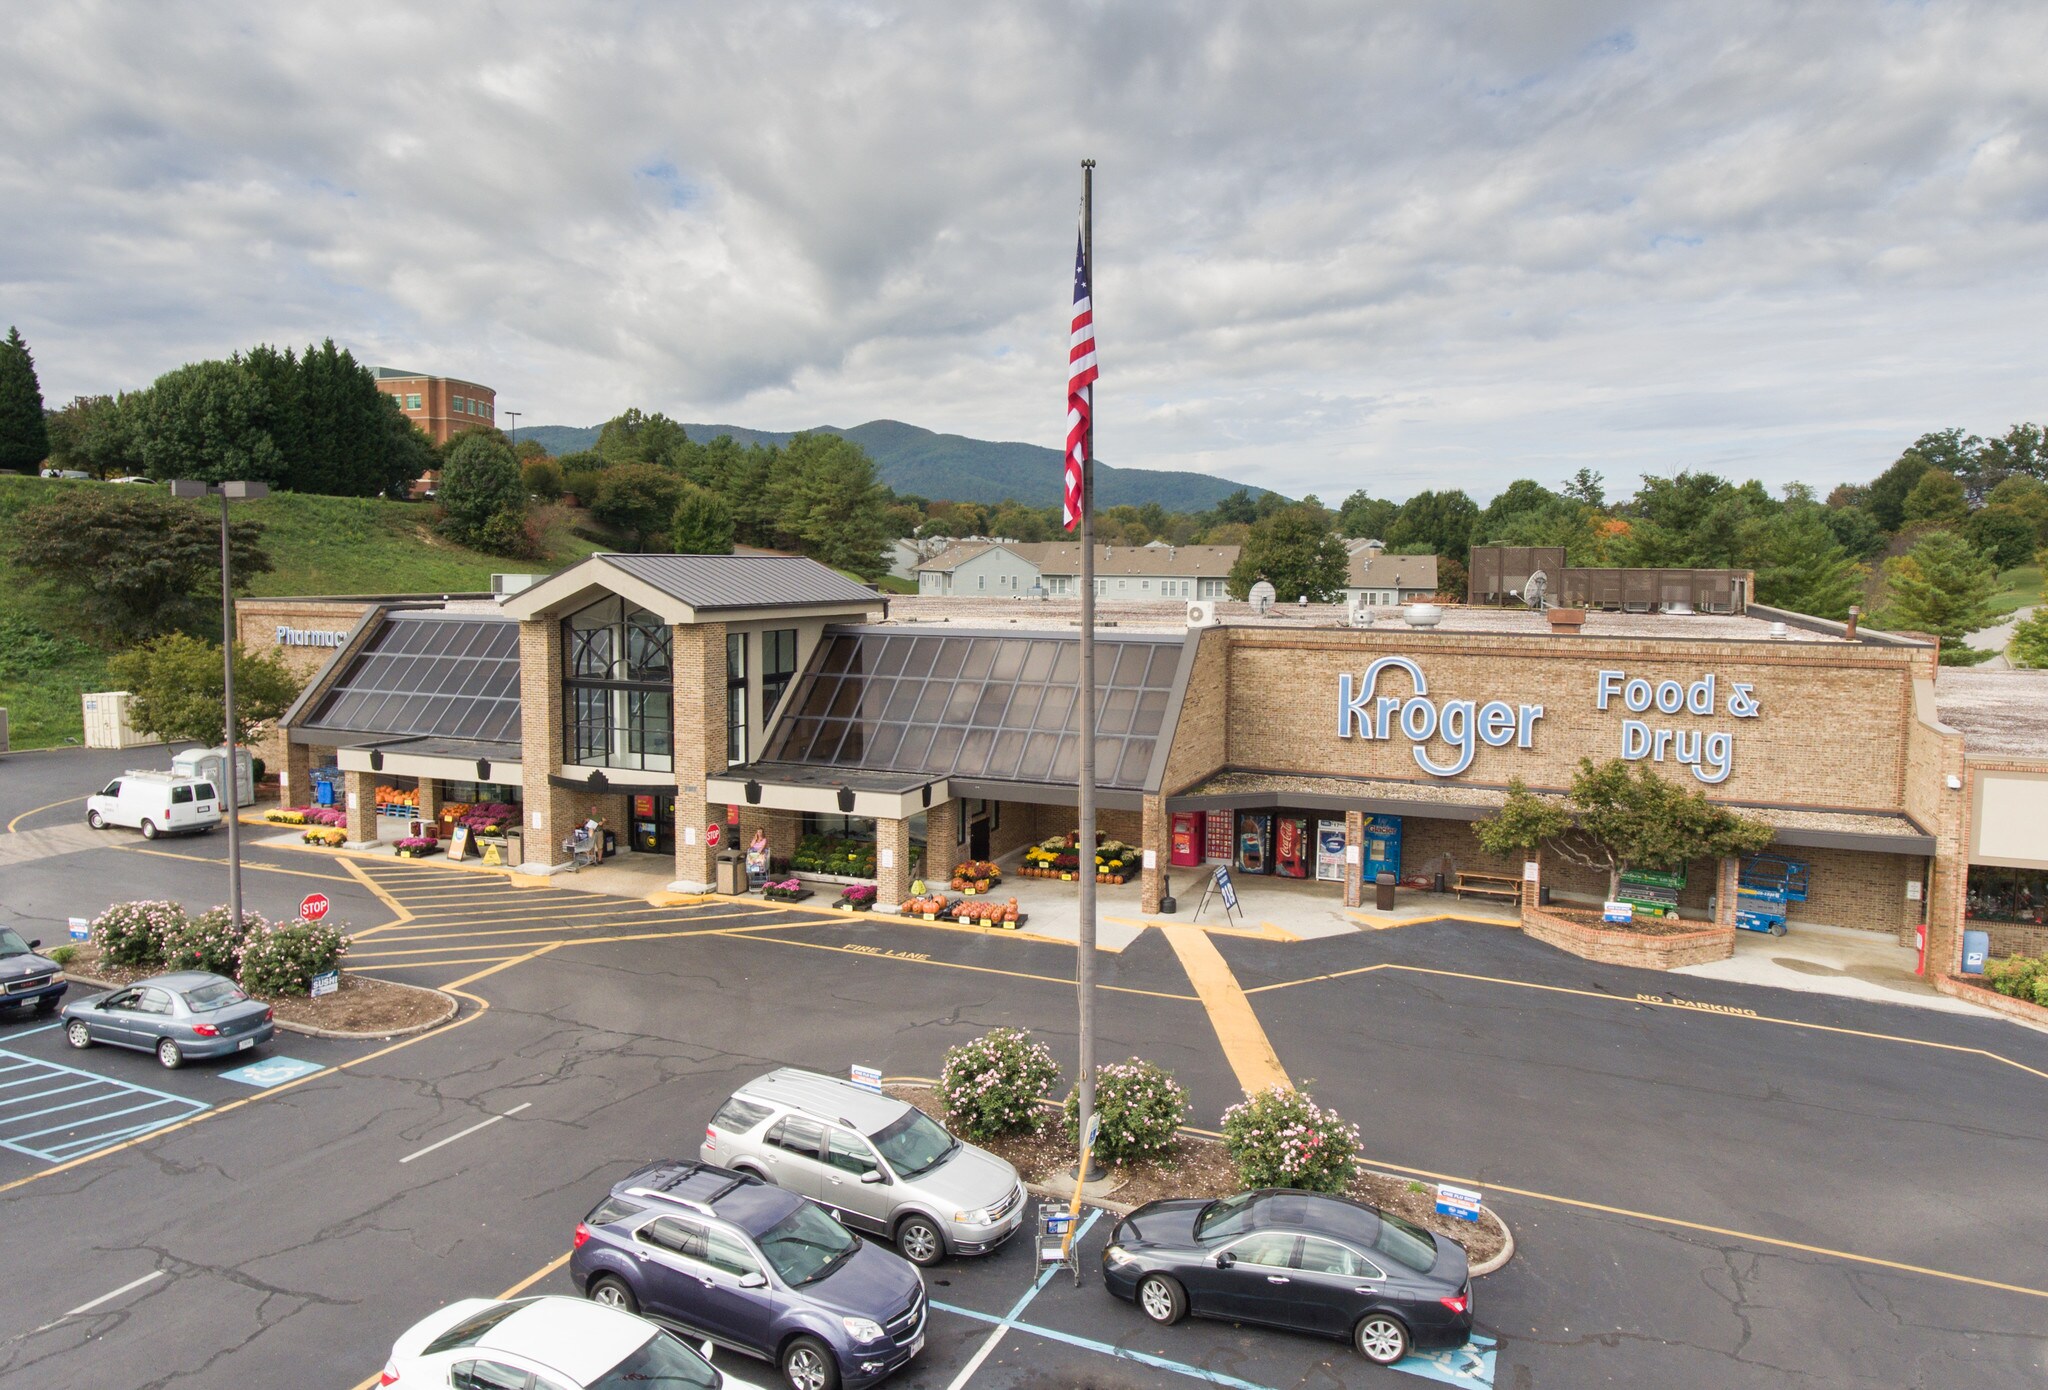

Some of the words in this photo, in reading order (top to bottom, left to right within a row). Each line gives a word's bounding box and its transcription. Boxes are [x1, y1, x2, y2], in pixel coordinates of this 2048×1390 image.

[276, 626, 349, 646] Pharmac
[1597, 670, 1715, 715] Food
[1728, 682, 1760, 717] &
[1338, 656, 1543, 776] Kroger
[1621, 720, 1732, 783] Drug
[707, 829, 719, 840] STOP
[302, 900, 327, 915] STOP
[843, 944, 882, 953] FIRE
[885, 950, 931, 960] LANE
[313, 976, 338, 989] SUSHI
[1637, 994, 1663, 1002] NO
[1672, 999, 1757, 1016] PARKING
